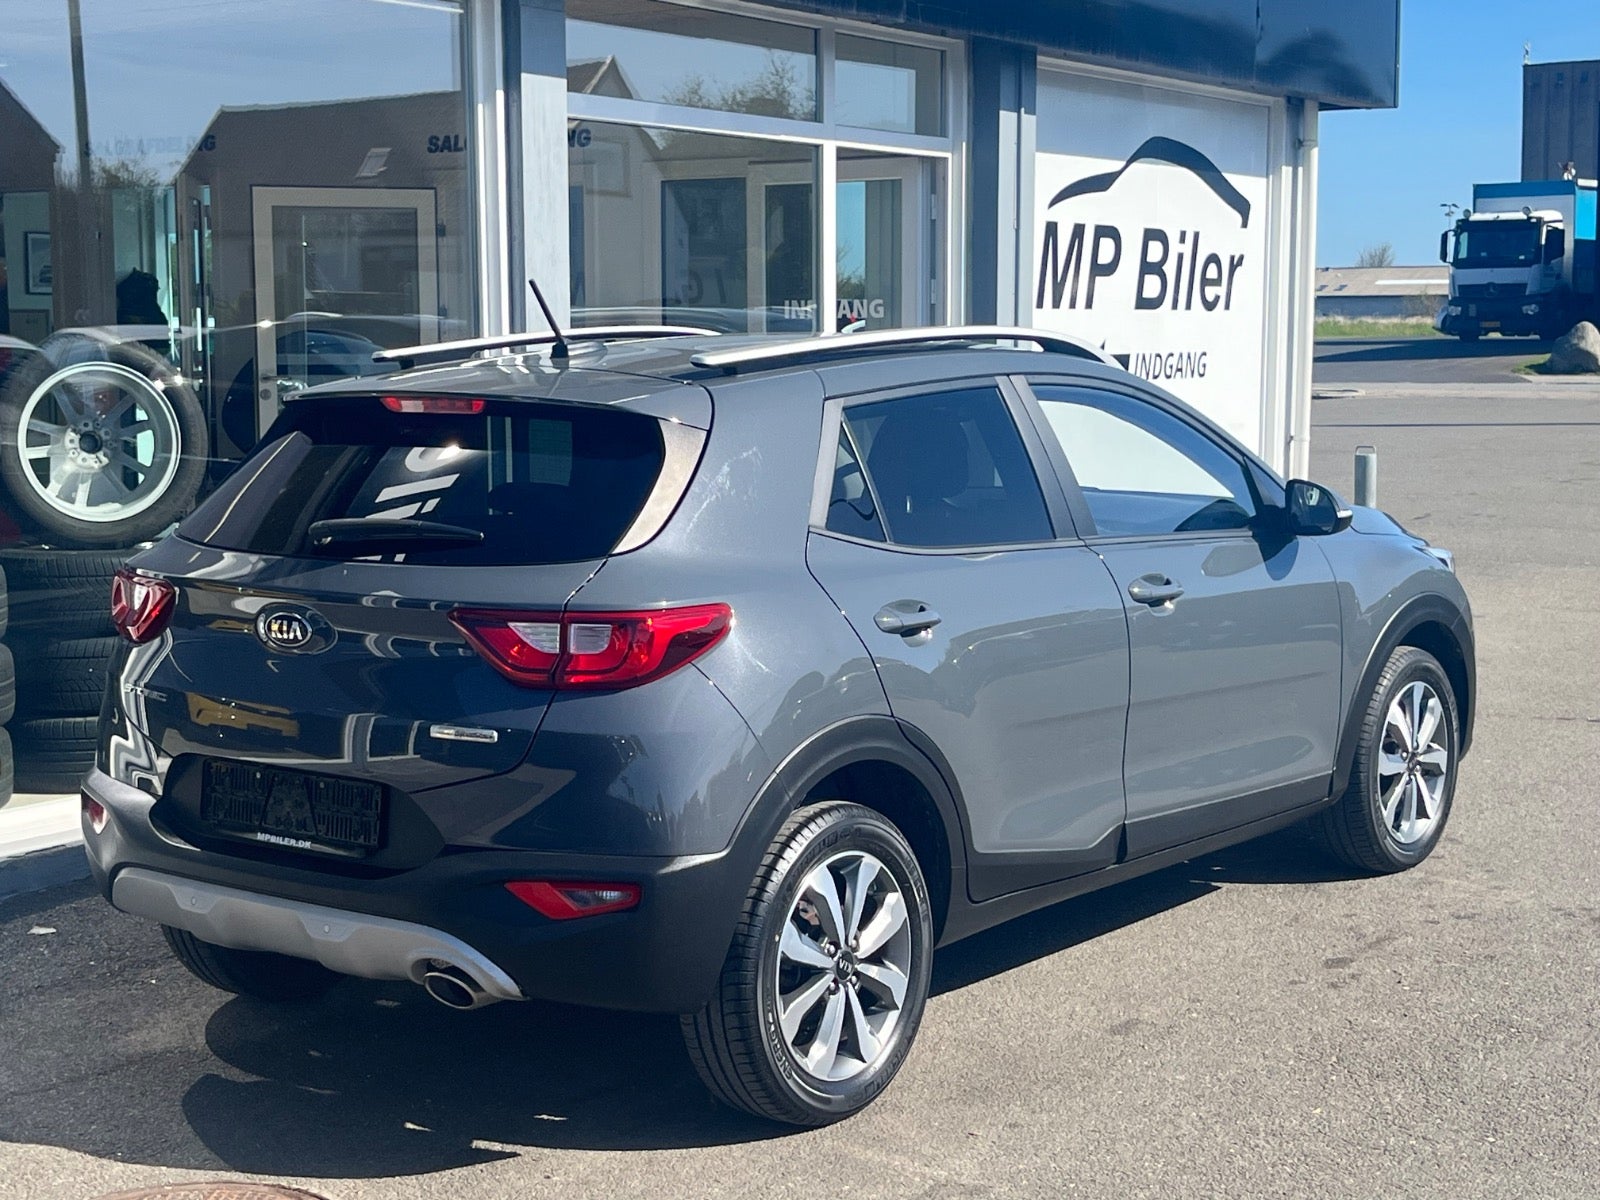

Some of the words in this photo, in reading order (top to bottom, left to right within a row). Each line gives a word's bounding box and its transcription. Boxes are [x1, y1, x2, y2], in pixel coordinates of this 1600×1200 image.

[1035, 220, 1122, 310] MP
[1134, 227, 1245, 312] Biler
[1134, 351, 1208, 380] INDGANG
[270, 619, 303, 640] KIA
[257, 831, 312, 849] MPBILER.DK
